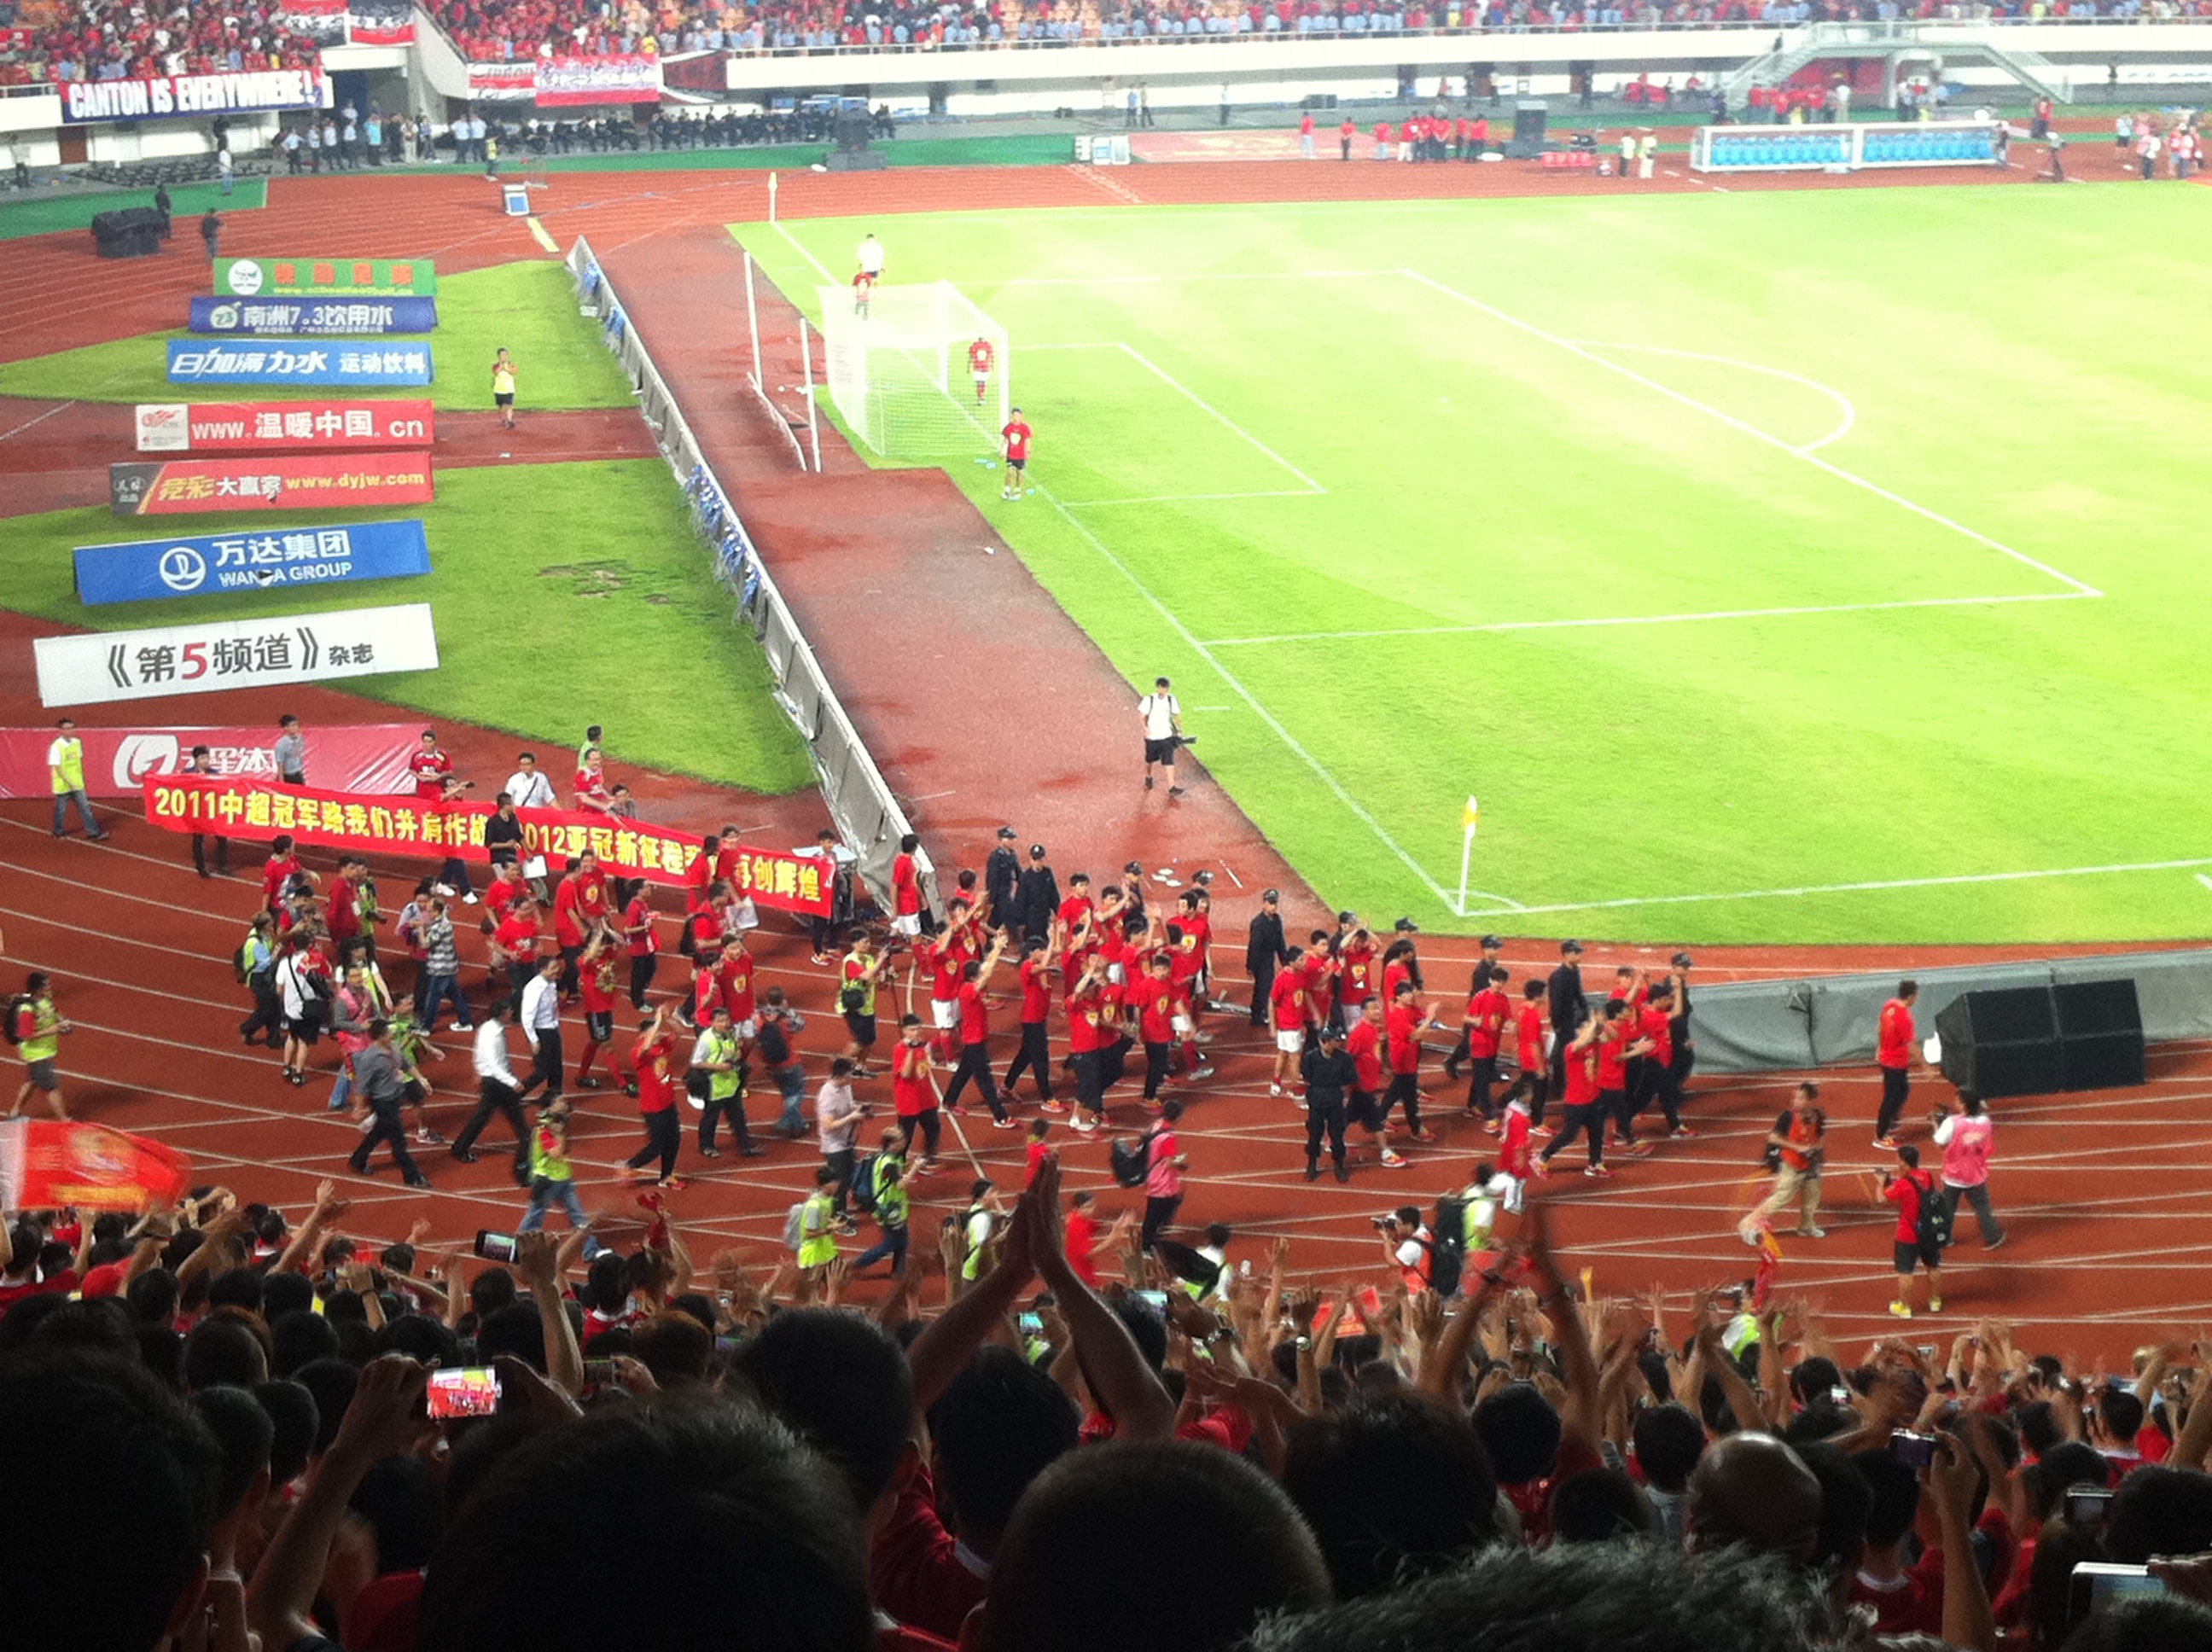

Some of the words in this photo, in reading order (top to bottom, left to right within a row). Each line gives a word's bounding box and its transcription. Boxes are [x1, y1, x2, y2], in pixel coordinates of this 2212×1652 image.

[68, 81, 148, 118] CANTON
[150, 79, 173, 113] IS
[176, 70, 316, 111] EVERYWHERE!
[340, 352, 425, 375] 运动饮料
[287, 473, 425, 491] www.dyjw.com
[212, 530, 351, 567] 万达集团
[218, 570, 287, 587] WANA
[289, 562, 352, 580] GROUP
[108, 626, 319, 688] 《第5频道》
[329, 643, 374, 666] 杂志
